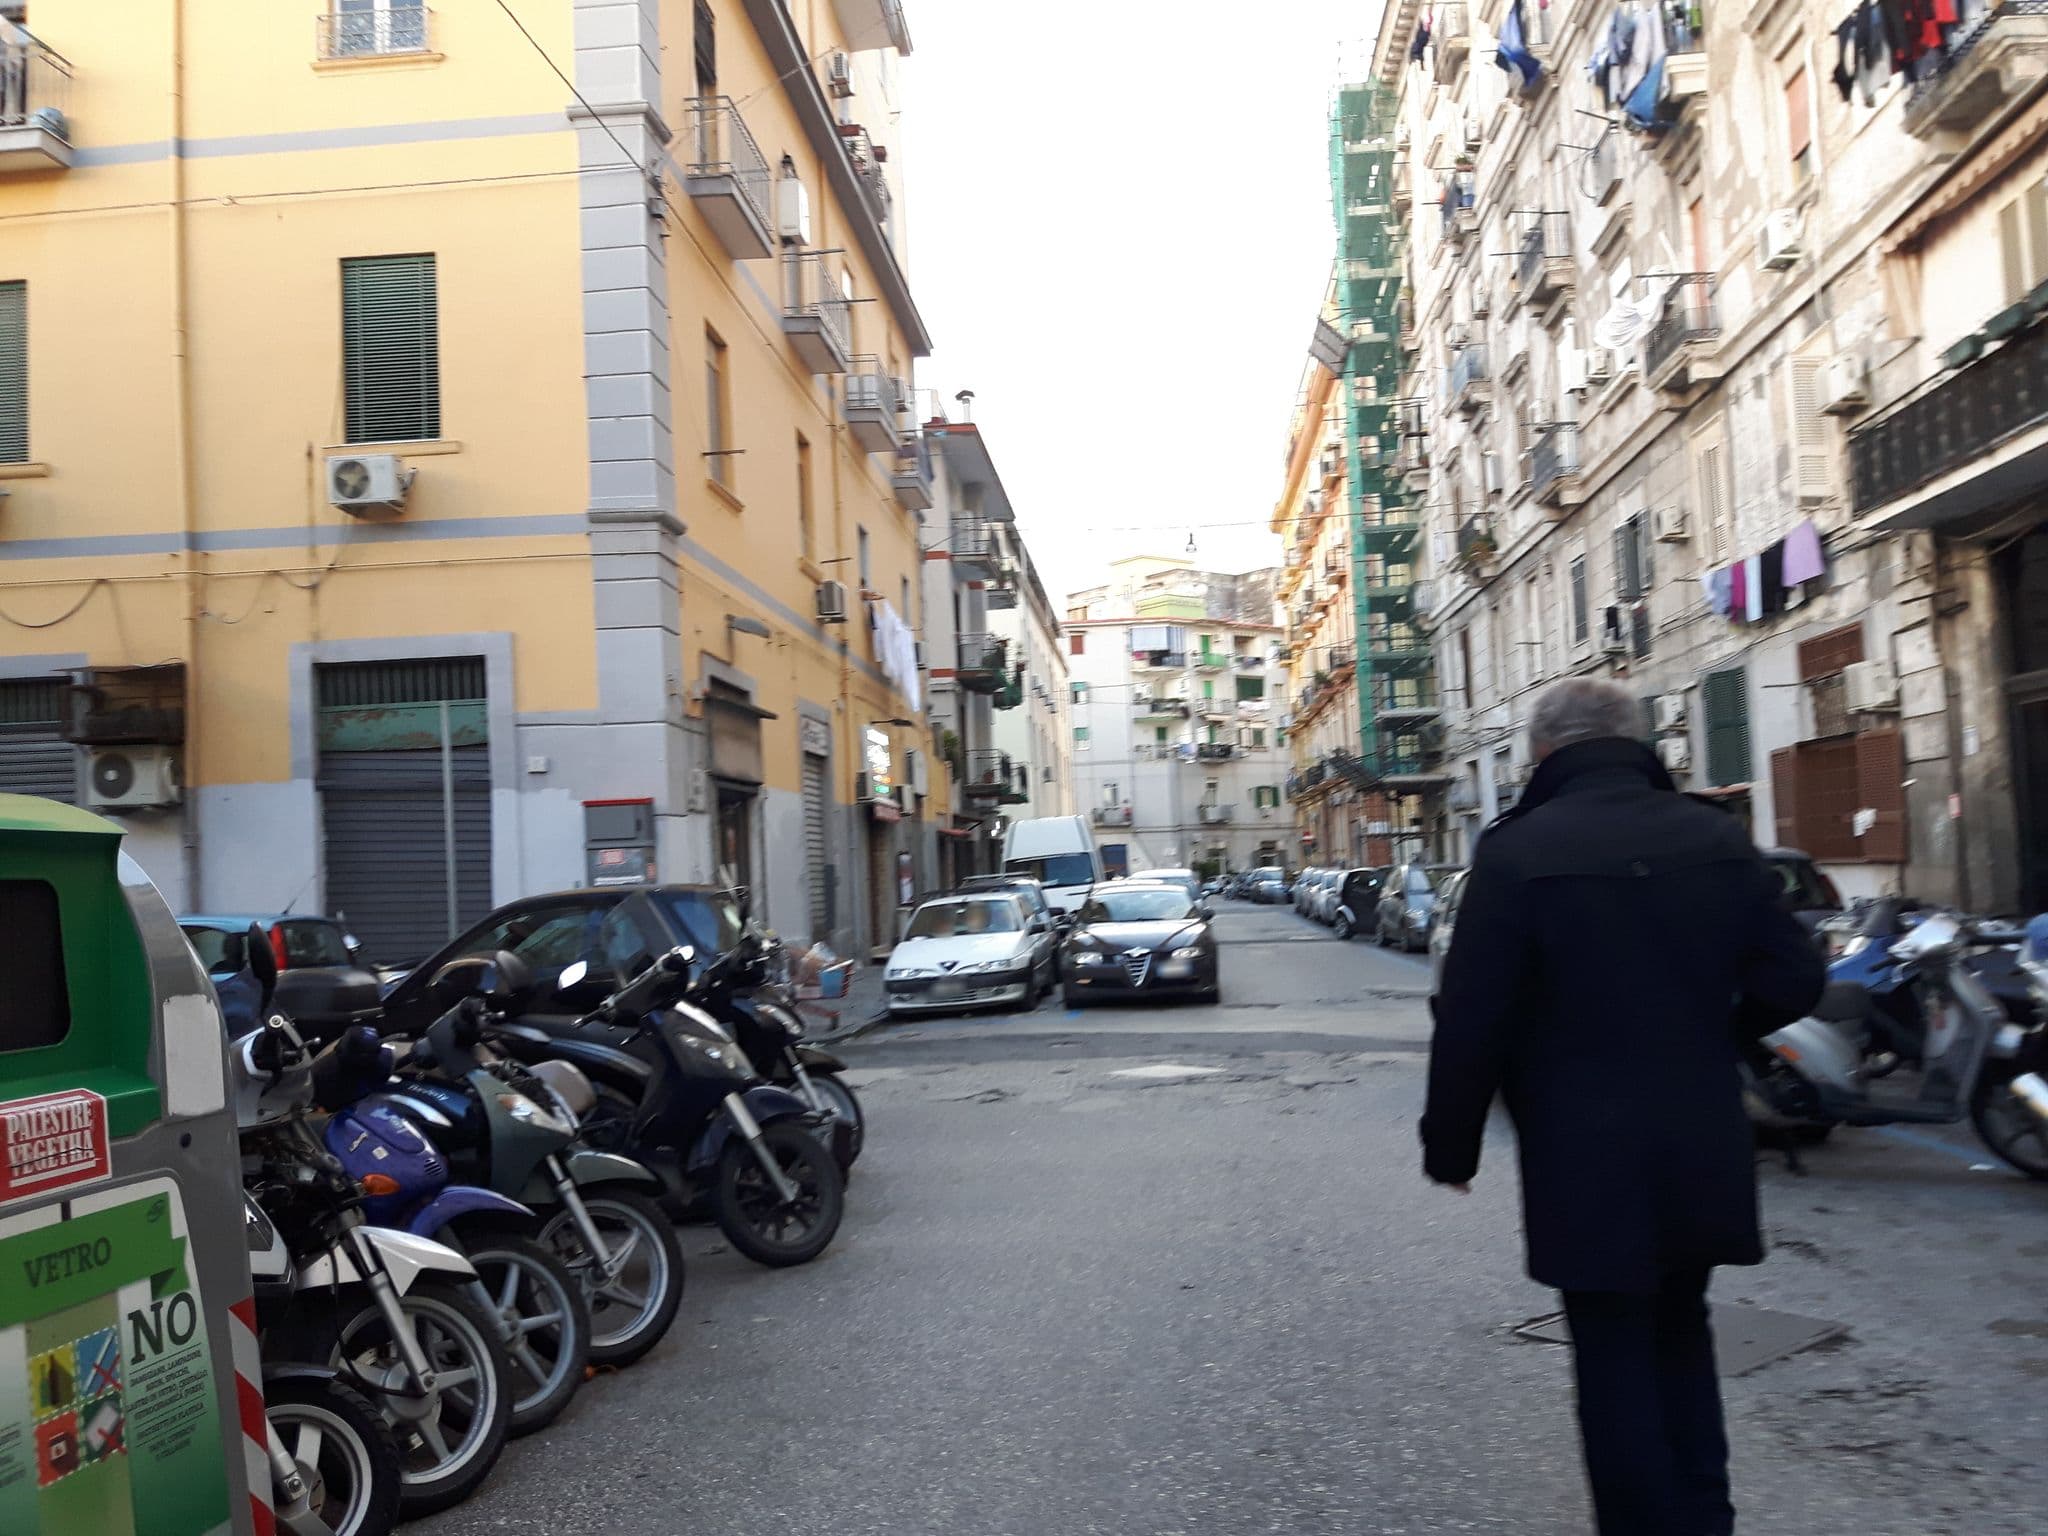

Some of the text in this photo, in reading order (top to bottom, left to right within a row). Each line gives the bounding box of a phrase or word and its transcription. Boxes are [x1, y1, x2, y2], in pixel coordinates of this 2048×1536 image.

[7, 1100, 94, 1146] PALESTRE
[23, 1236, 112, 1288] VETRO
[128, 1291, 197, 1365] NO
